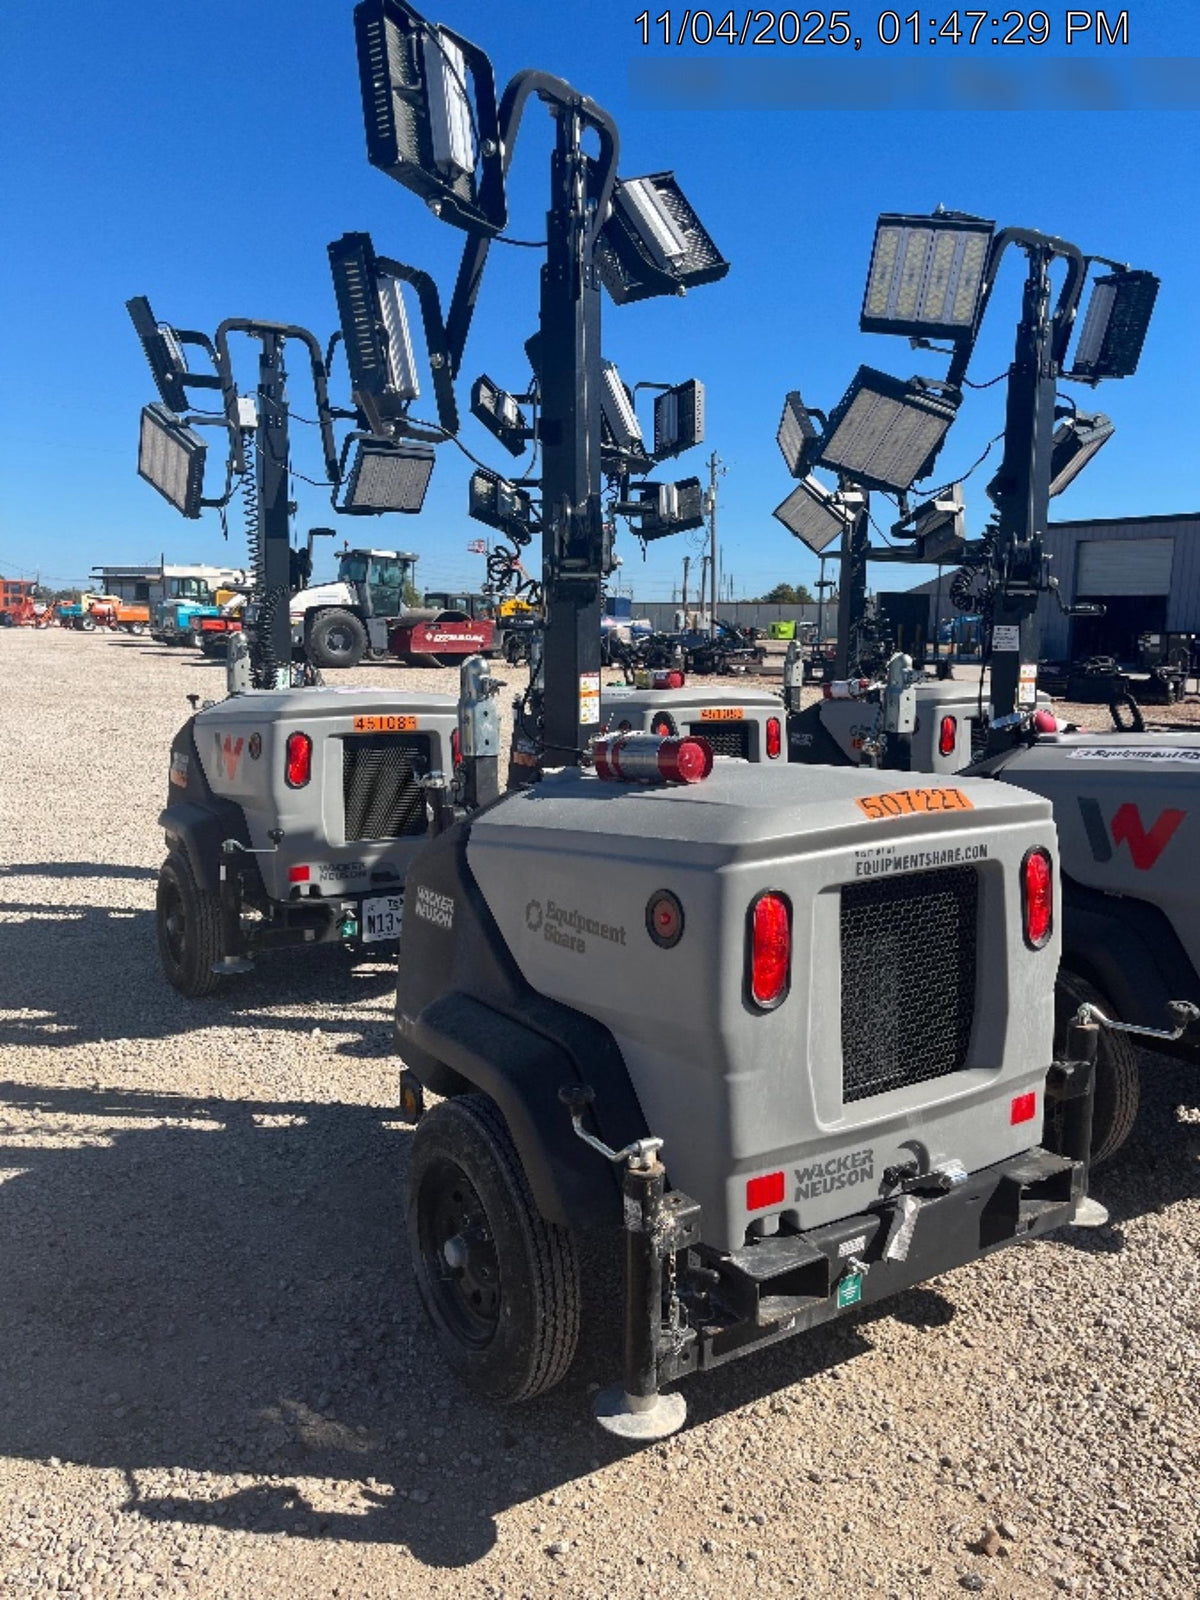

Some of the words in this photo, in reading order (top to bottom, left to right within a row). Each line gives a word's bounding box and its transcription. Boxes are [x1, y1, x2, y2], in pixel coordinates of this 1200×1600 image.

[860, 788, 967, 818] 507227
[543, 922, 586, 954] Share
[545, 899, 627, 947] Equipment
[794, 1148, 874, 1185] WACKER
[794, 1164, 874, 1203] NEUSON
